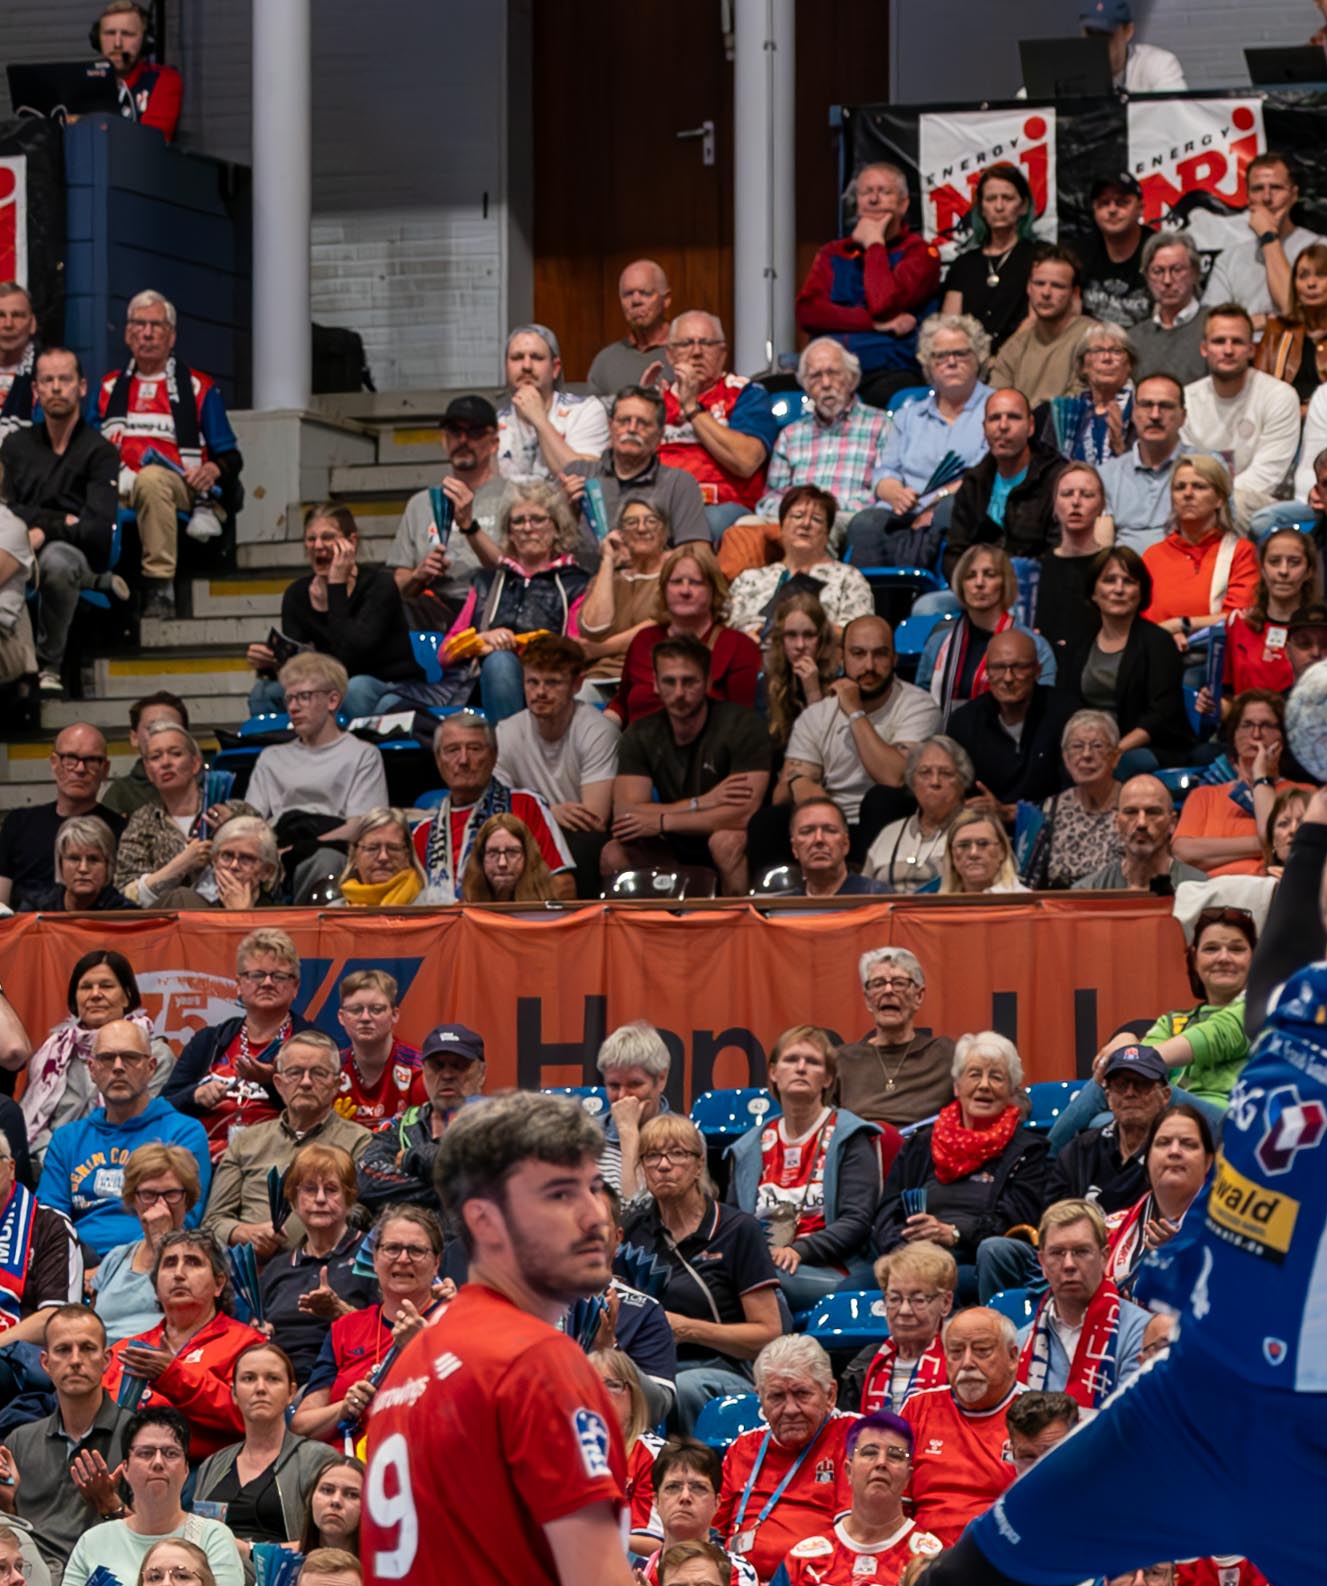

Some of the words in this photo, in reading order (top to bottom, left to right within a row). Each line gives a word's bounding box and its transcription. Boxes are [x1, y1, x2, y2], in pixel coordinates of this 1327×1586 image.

[925, 137, 1020, 186] ENERGY
[1136, 127, 1230, 174] ENERGY
[368, 1433, 418, 1579] 9
